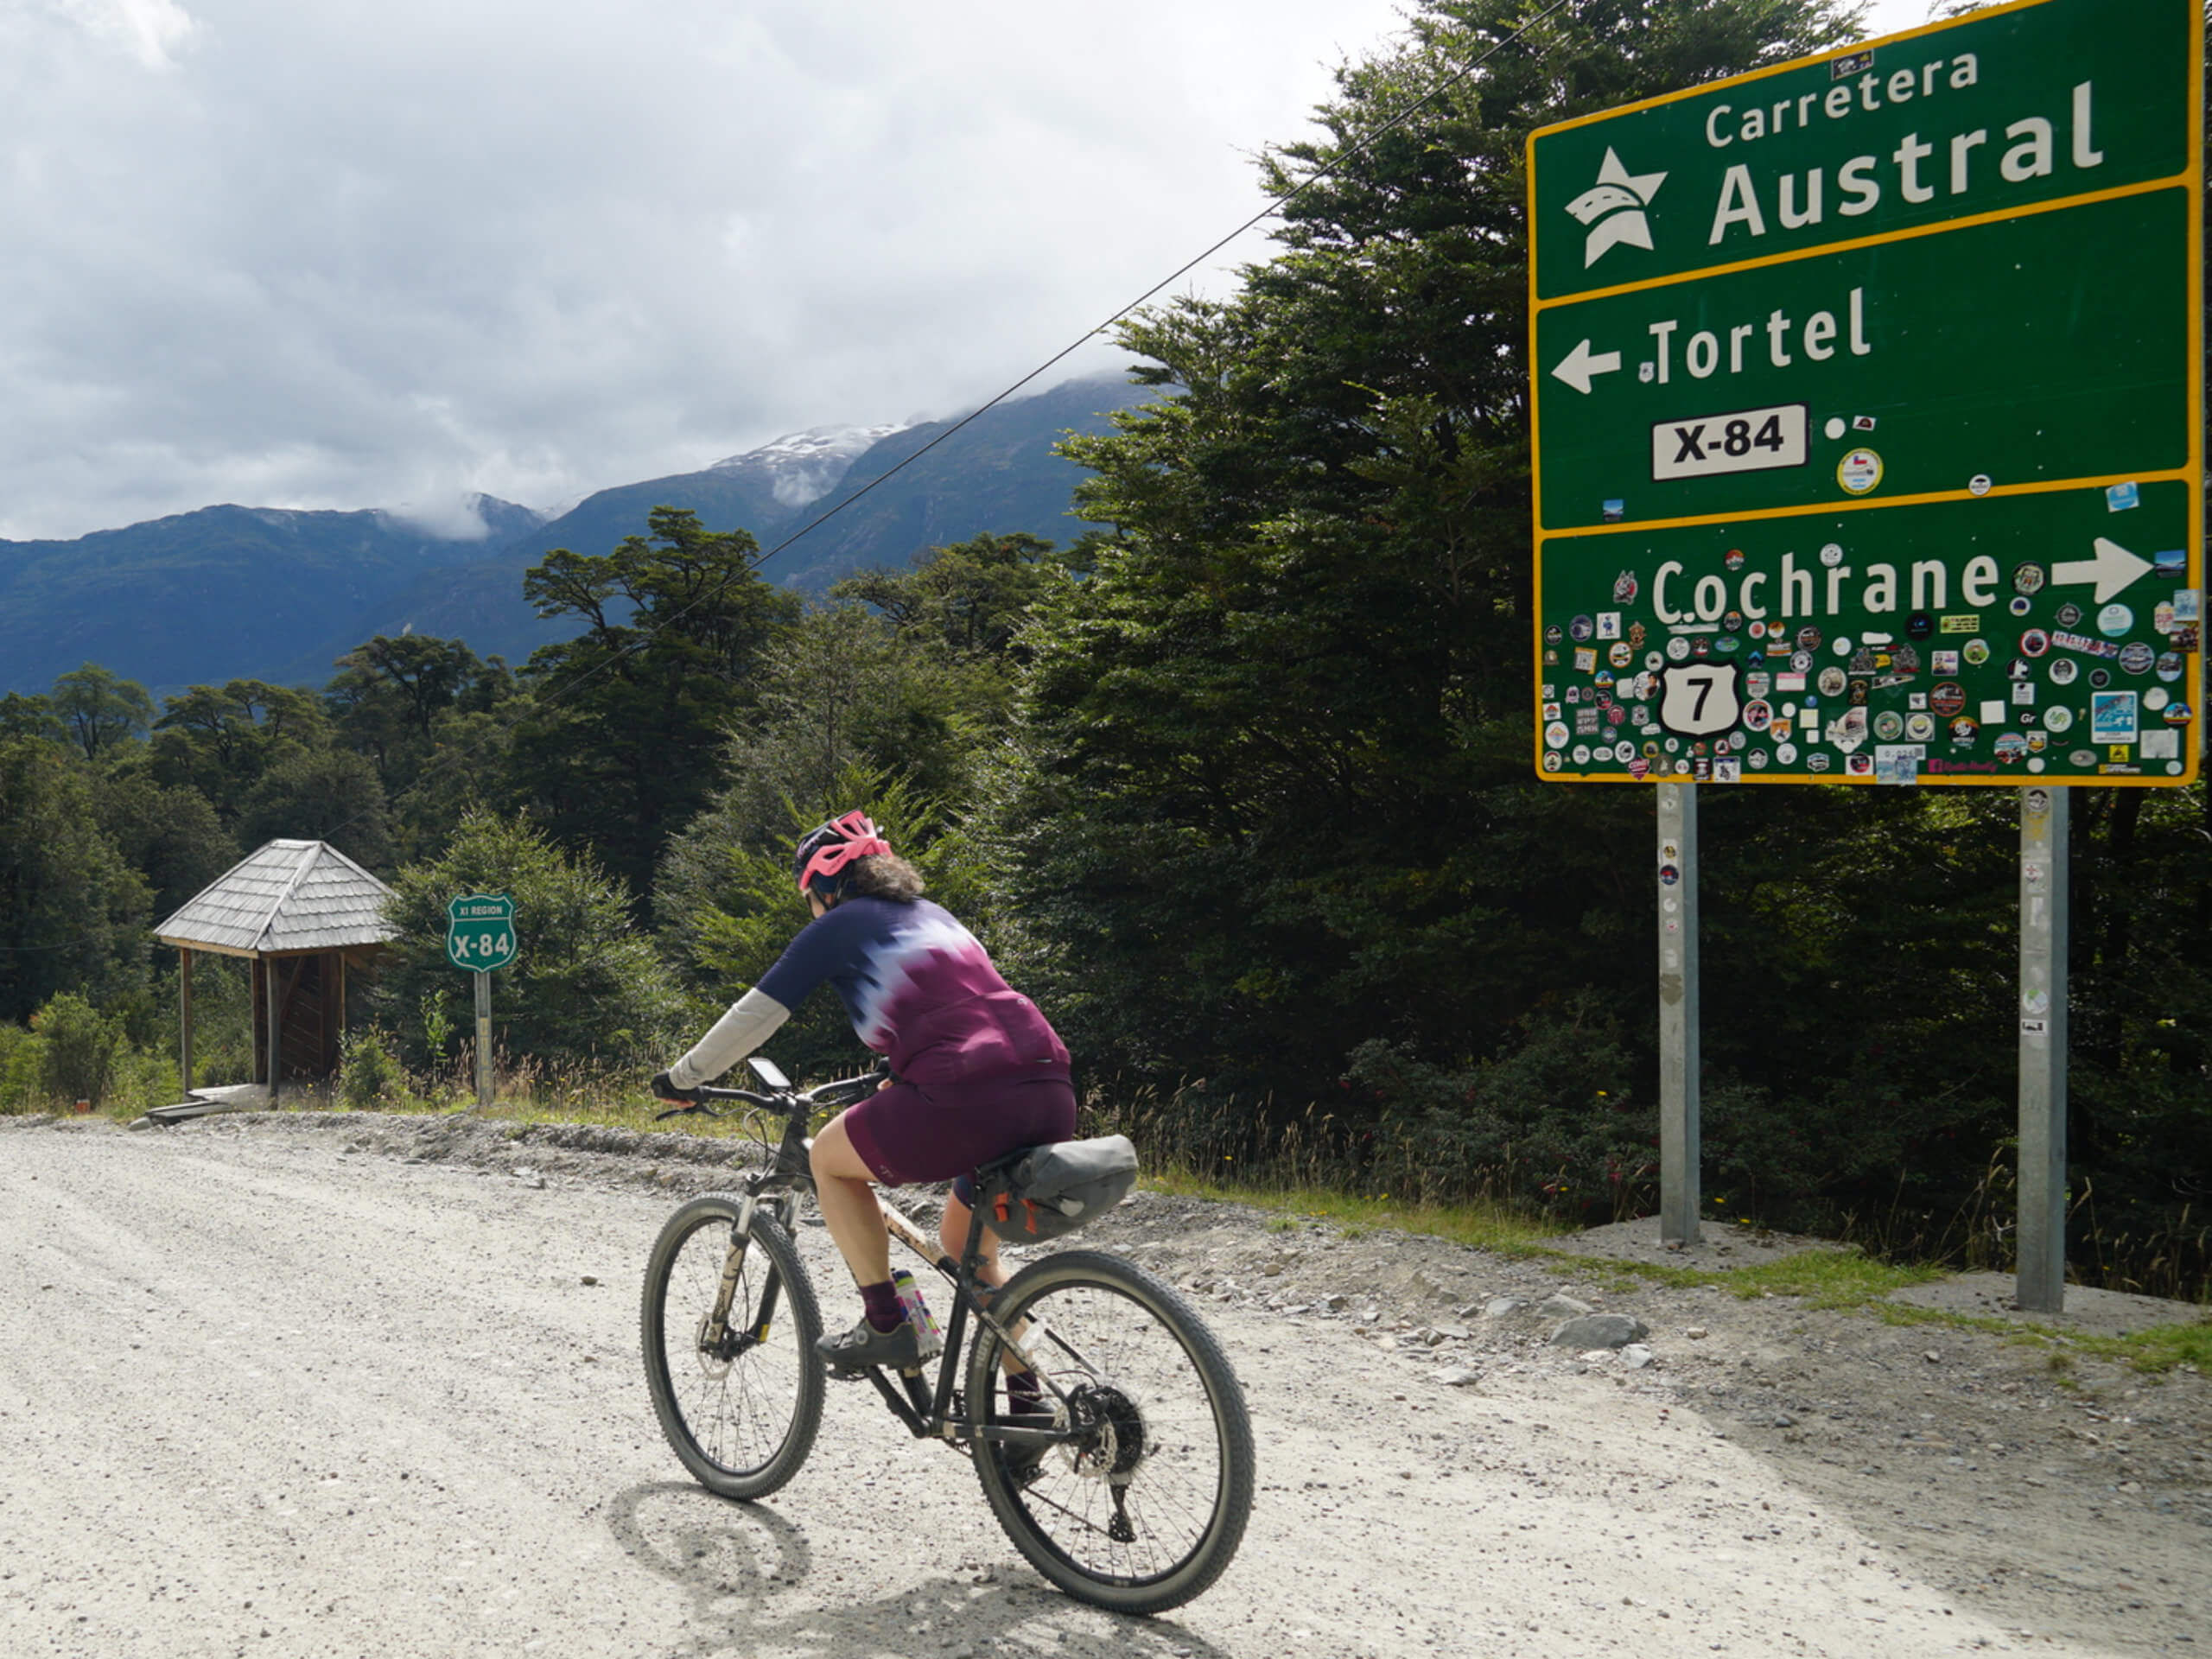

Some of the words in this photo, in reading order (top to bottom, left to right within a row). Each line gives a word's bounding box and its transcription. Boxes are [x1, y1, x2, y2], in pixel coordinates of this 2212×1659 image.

[1707, 53, 1978, 148] Carretera
[1708, 81, 2103, 246] Austral
[1649, 287, 1872, 385] Tortel
[1673, 414, 1785, 464] X-84
[1652, 551, 1999, 625] Cochrane
[1687, 677, 1713, 722] 7
[460, 906, 468, 916] XI
[471, 906, 503, 915] REGION
[454, 933, 509, 958] X-84
